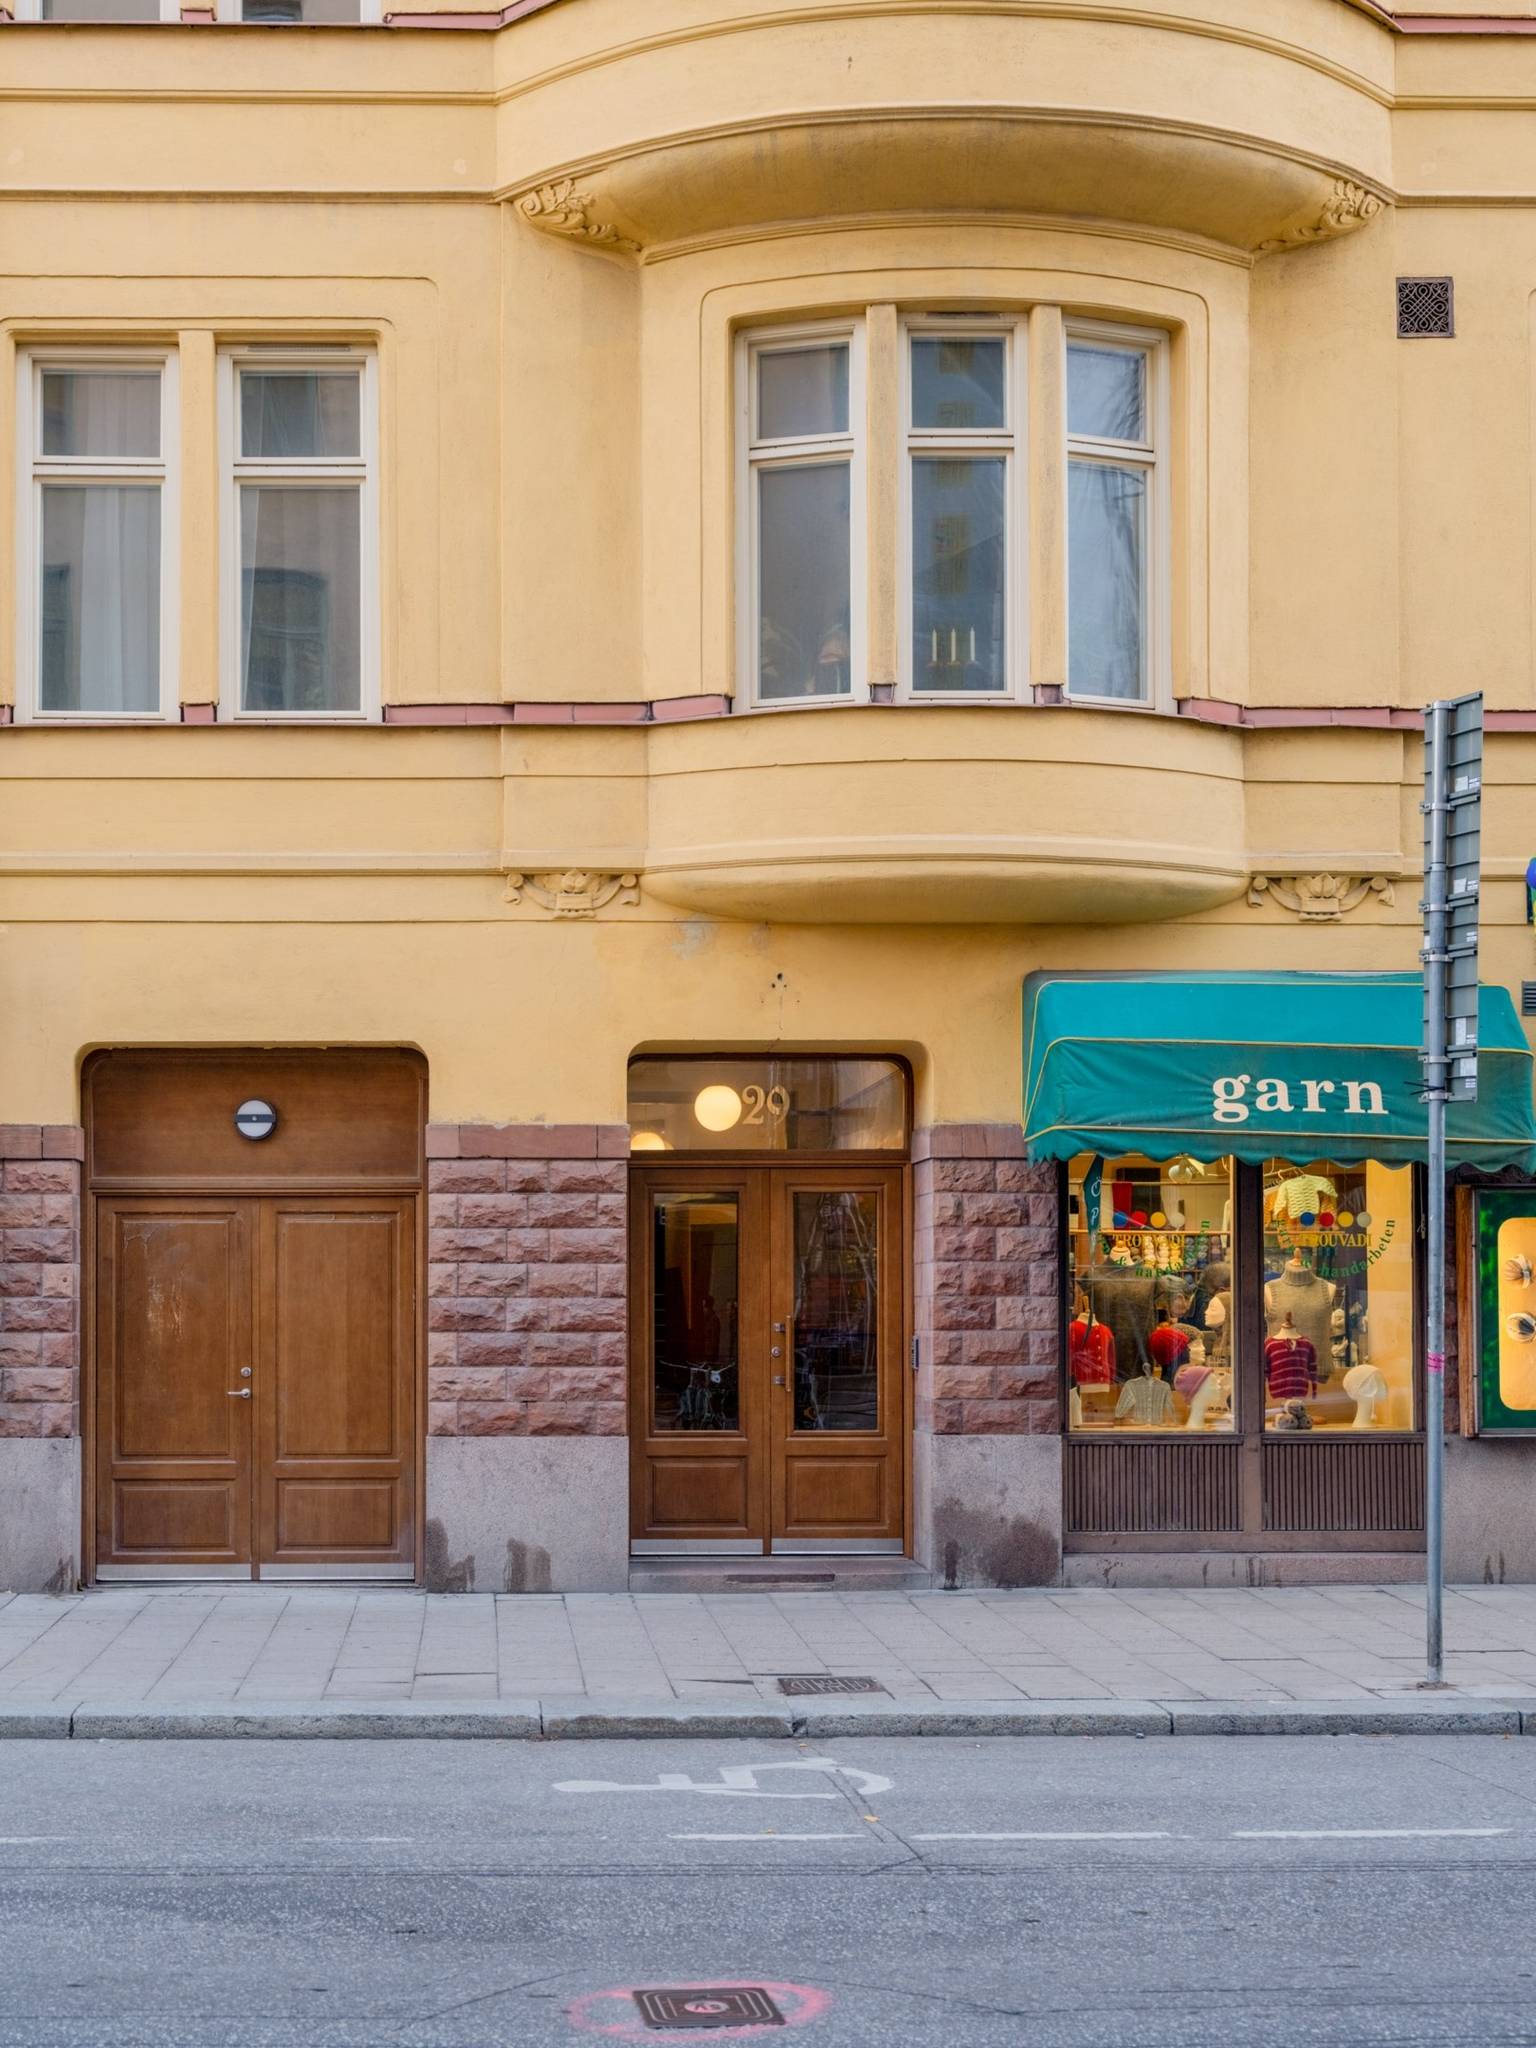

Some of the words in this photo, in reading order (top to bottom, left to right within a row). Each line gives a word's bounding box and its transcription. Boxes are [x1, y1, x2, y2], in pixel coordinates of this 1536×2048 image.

[742, 1085, 790, 1125] 29
[1212, 1074, 1389, 1123] garn
[1319, 1219, 1396, 1279] handarbeten
